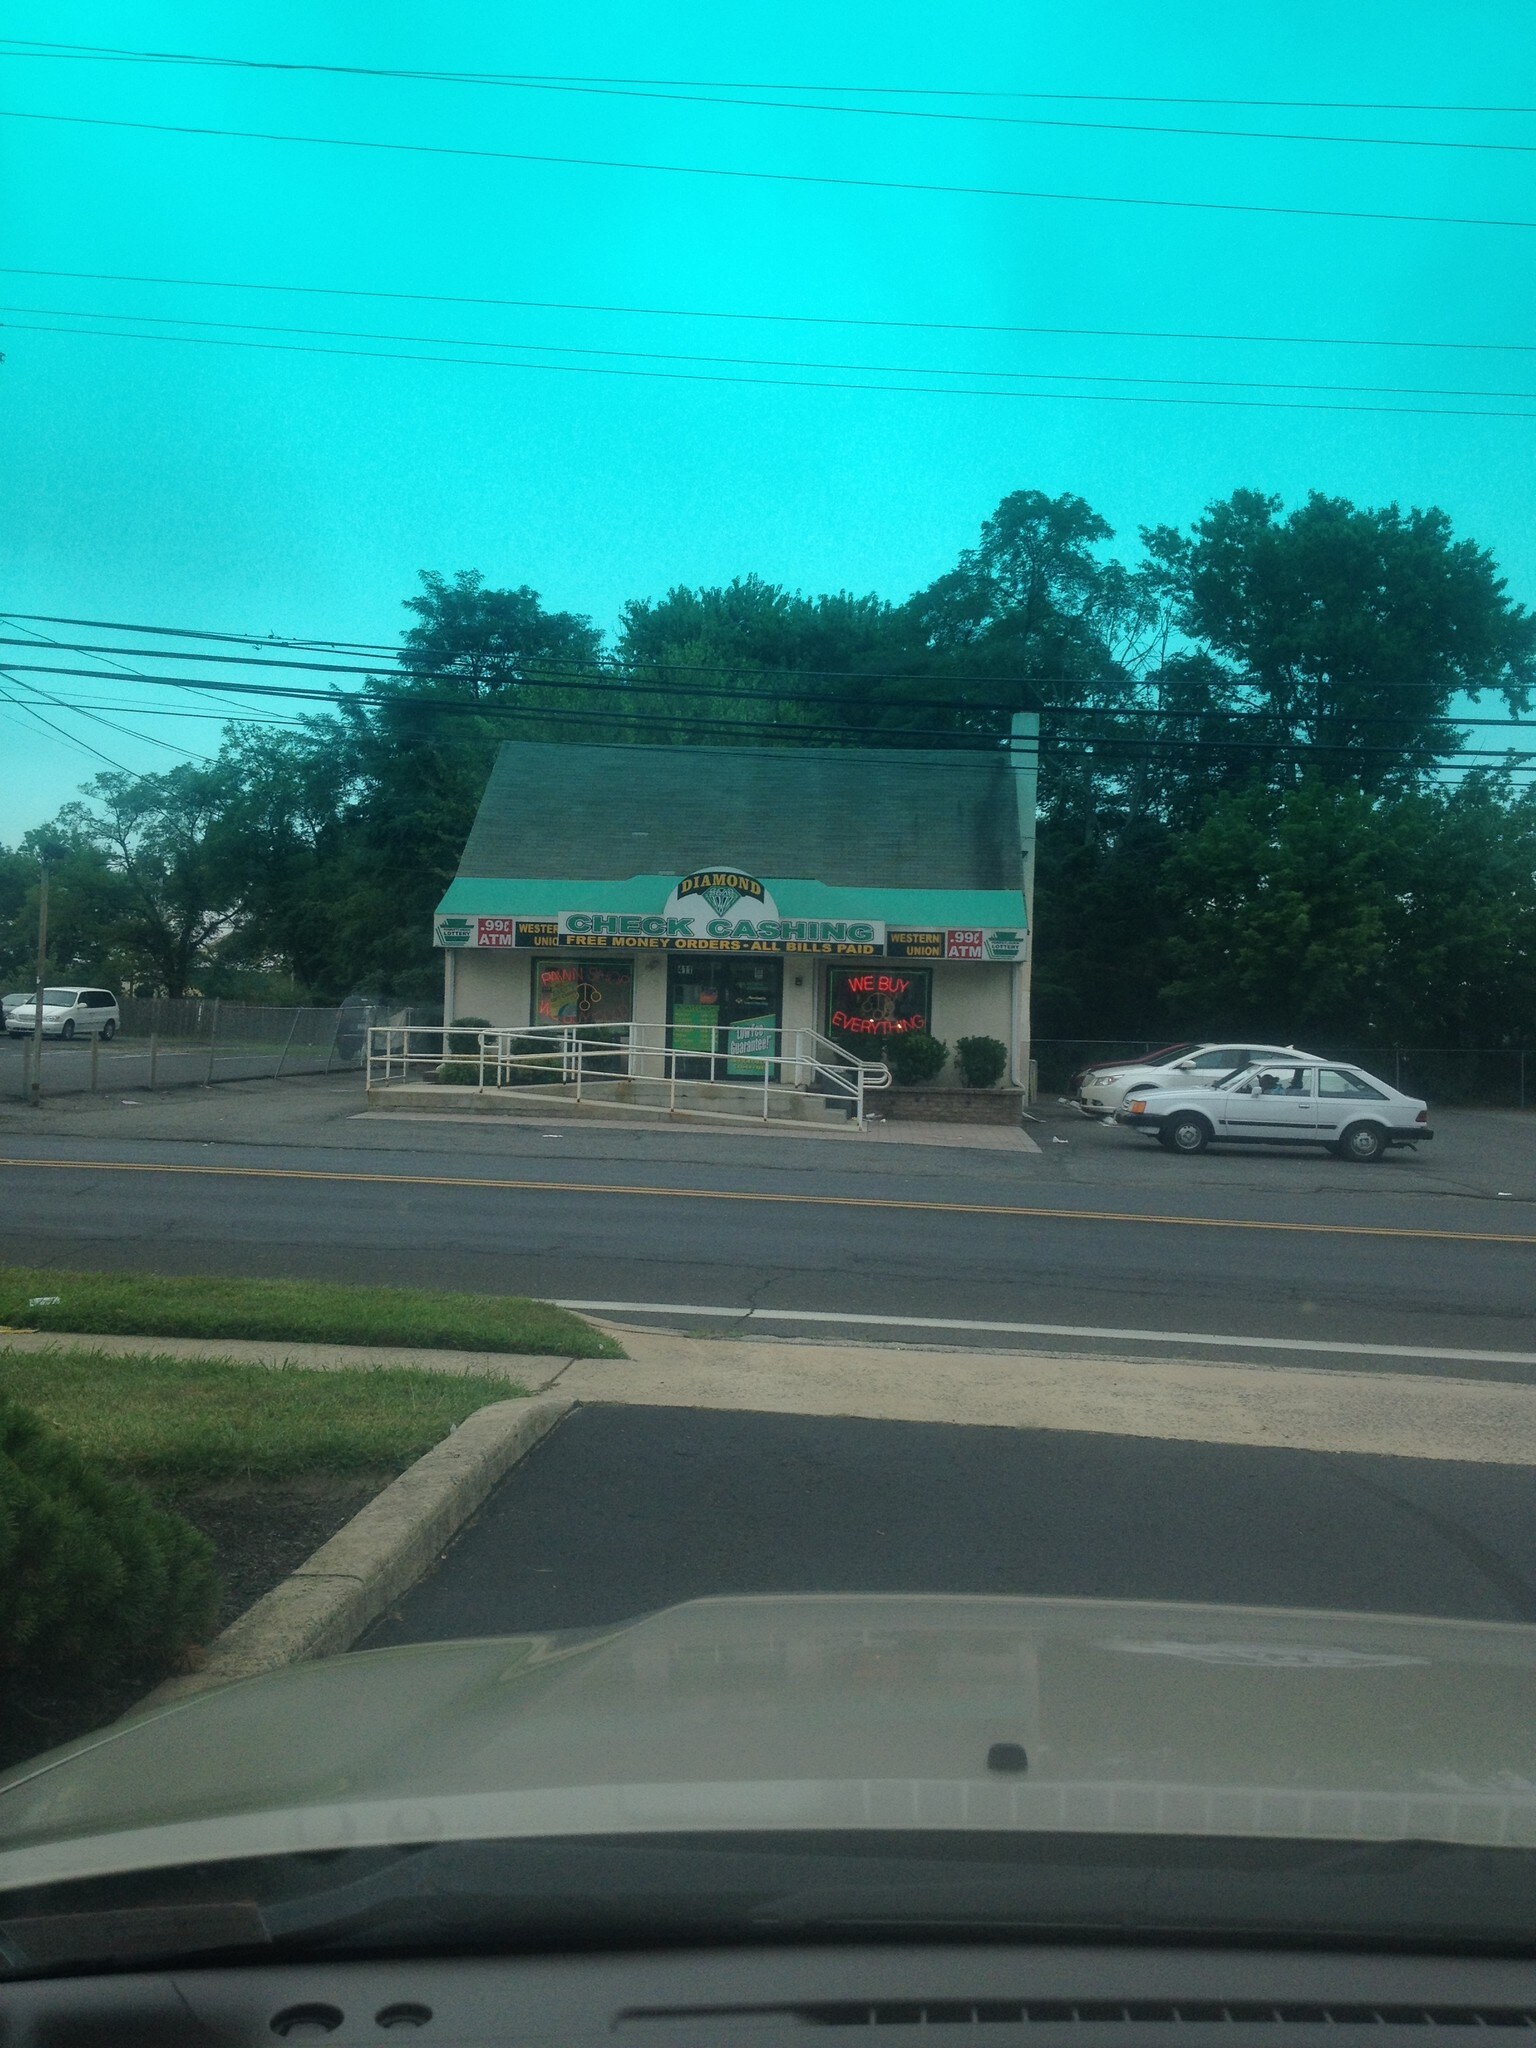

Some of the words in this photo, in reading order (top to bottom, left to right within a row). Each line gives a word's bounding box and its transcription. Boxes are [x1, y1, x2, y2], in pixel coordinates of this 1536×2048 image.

[681, 872, 762, 896] DIAMOND
[518, 923, 559, 934] WESTER
[565, 913, 696, 937] CHECK
[706, 918, 875, 943] CASHING
[479, 934, 512, 945] ATM
[534, 936, 559, 946] UNIO
[566, 935, 608, 946] FREE
[612, 937, 669, 947] MONEY
[674, 939, 741, 950] ORDERS
[751, 941, 781, 951] ALL
[786, 943, 832, 952] BILLS
[837, 944, 875, 954] PAID
[891, 933, 940, 944] WESTERN
[906, 946, 940, 956] UNION
[948, 946, 982, 958] ATM
[848, 976, 875, 992] WE
[877, 976, 910, 993] BUY
[832, 1011, 925, 1035] EVERYTHING
